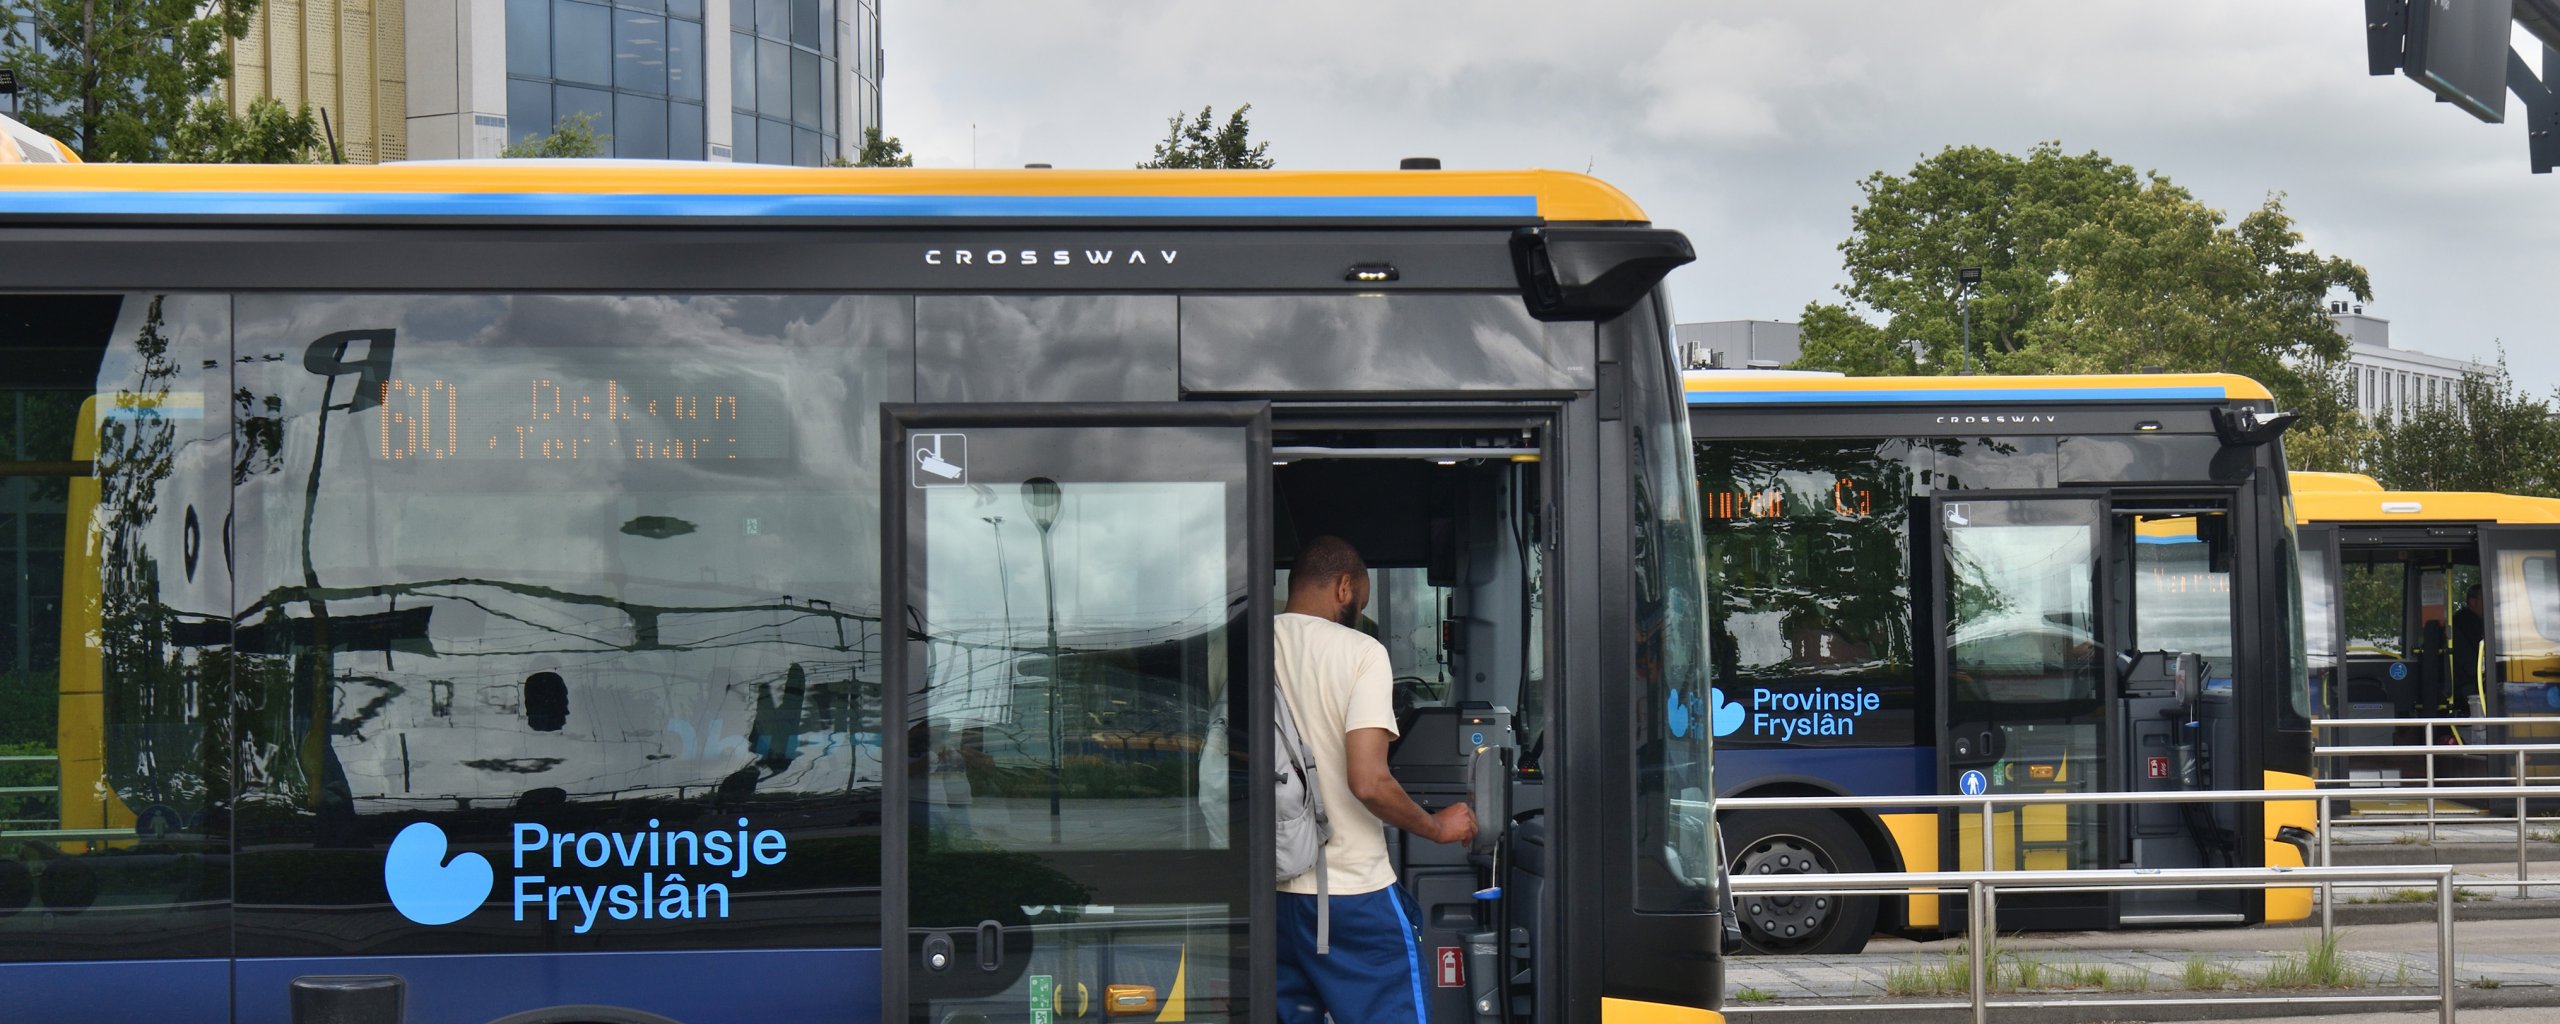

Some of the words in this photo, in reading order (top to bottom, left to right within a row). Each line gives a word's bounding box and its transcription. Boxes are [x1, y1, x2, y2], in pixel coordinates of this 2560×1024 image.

[1753, 687, 1880, 716] Provinsje
[1753, 713, 1854, 742] Fryslân
[513, 817, 787, 878] Provinsje
[513, 872, 729, 933] Fryslân
